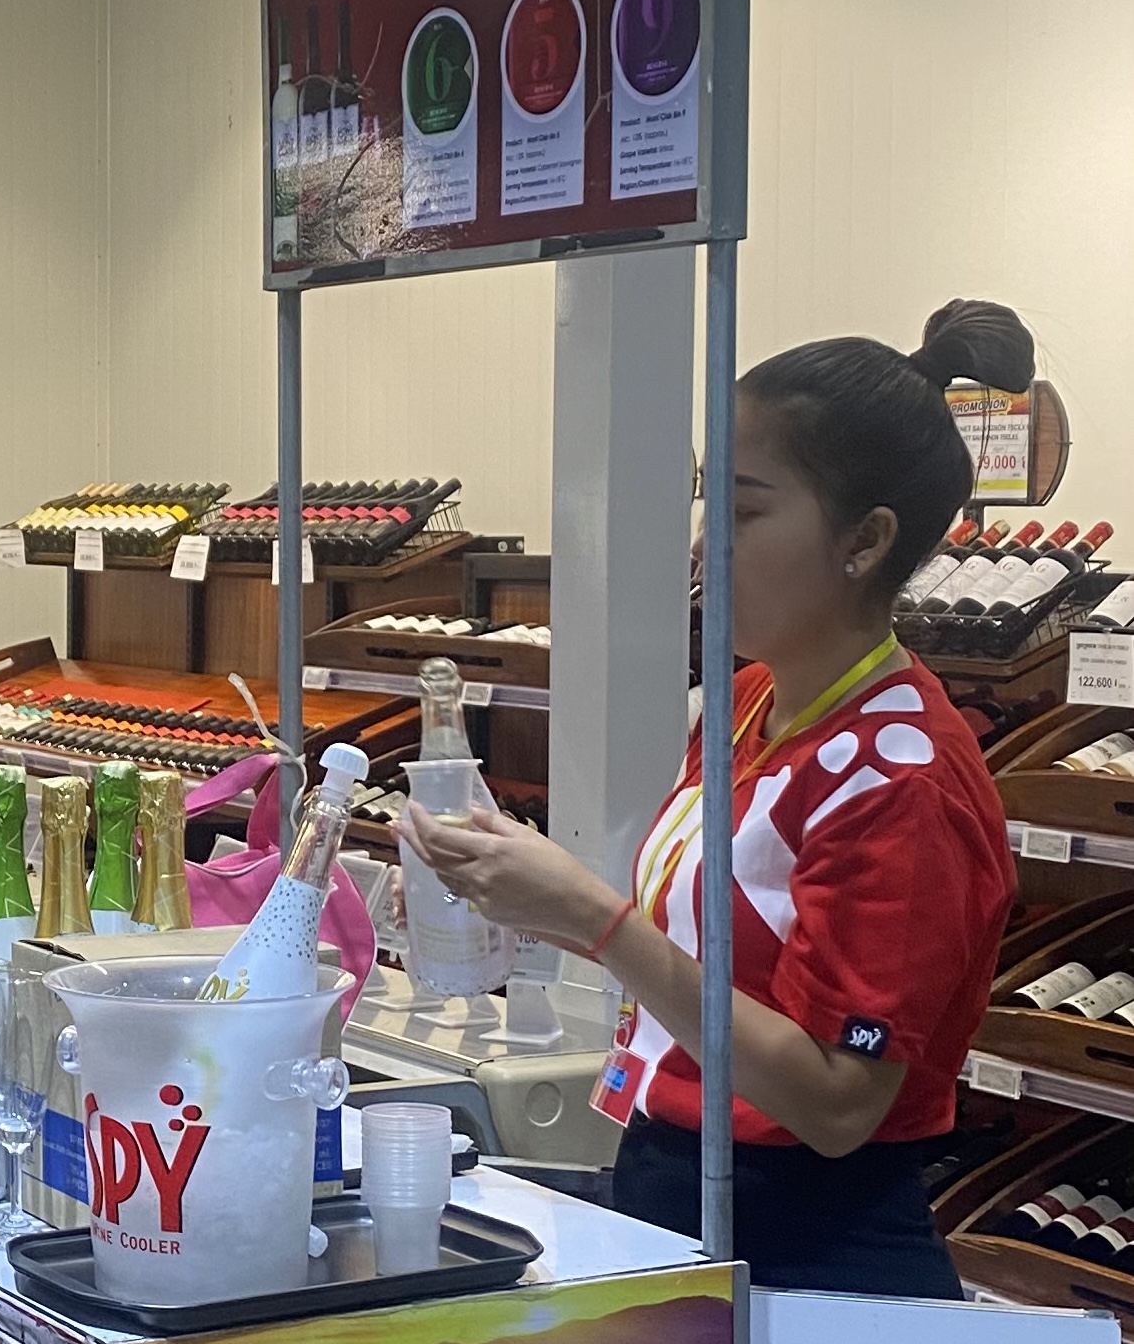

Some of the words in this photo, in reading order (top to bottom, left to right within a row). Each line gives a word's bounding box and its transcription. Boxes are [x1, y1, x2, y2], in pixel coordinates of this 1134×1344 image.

[425, 31, 453, 102] 6
[848, 1025, 882, 1051] SPY
[83, 1084, 212, 1234] SPY
[120, 1232, 181, 1255] COOLER
